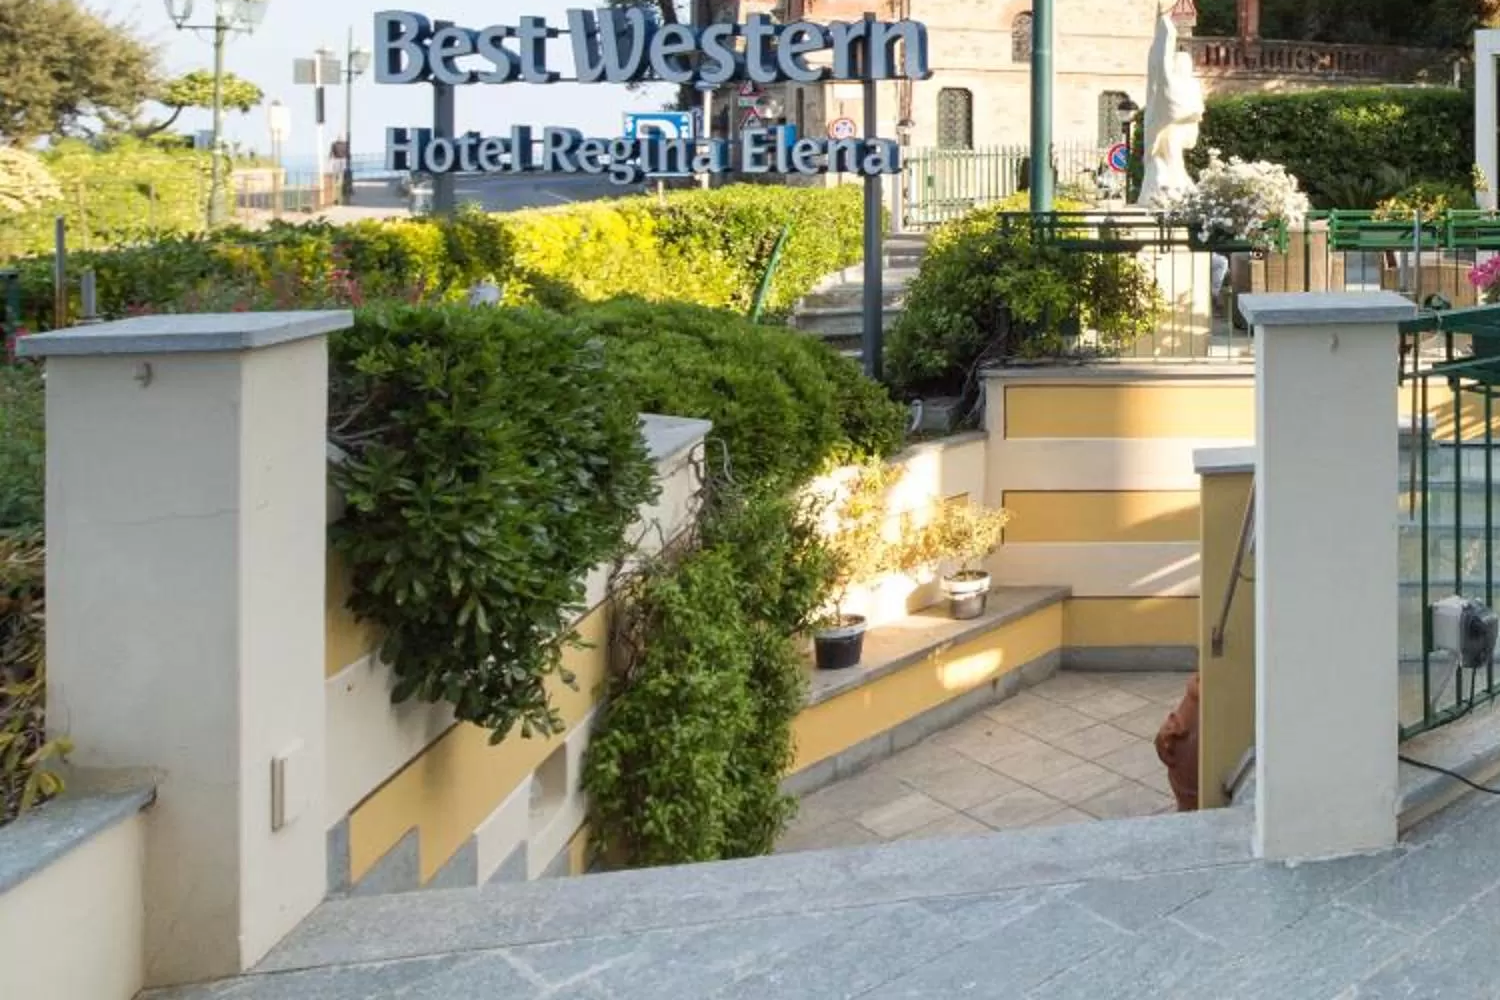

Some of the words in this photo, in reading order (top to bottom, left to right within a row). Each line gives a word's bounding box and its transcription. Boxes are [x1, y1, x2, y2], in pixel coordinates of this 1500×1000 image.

[374, 10, 550, 85] Best
[566, 8, 930, 84] Western
[384, 125, 532, 174] Hotel
[543, 126, 729, 185] Regina
[742, 126, 900, 174] Elena
